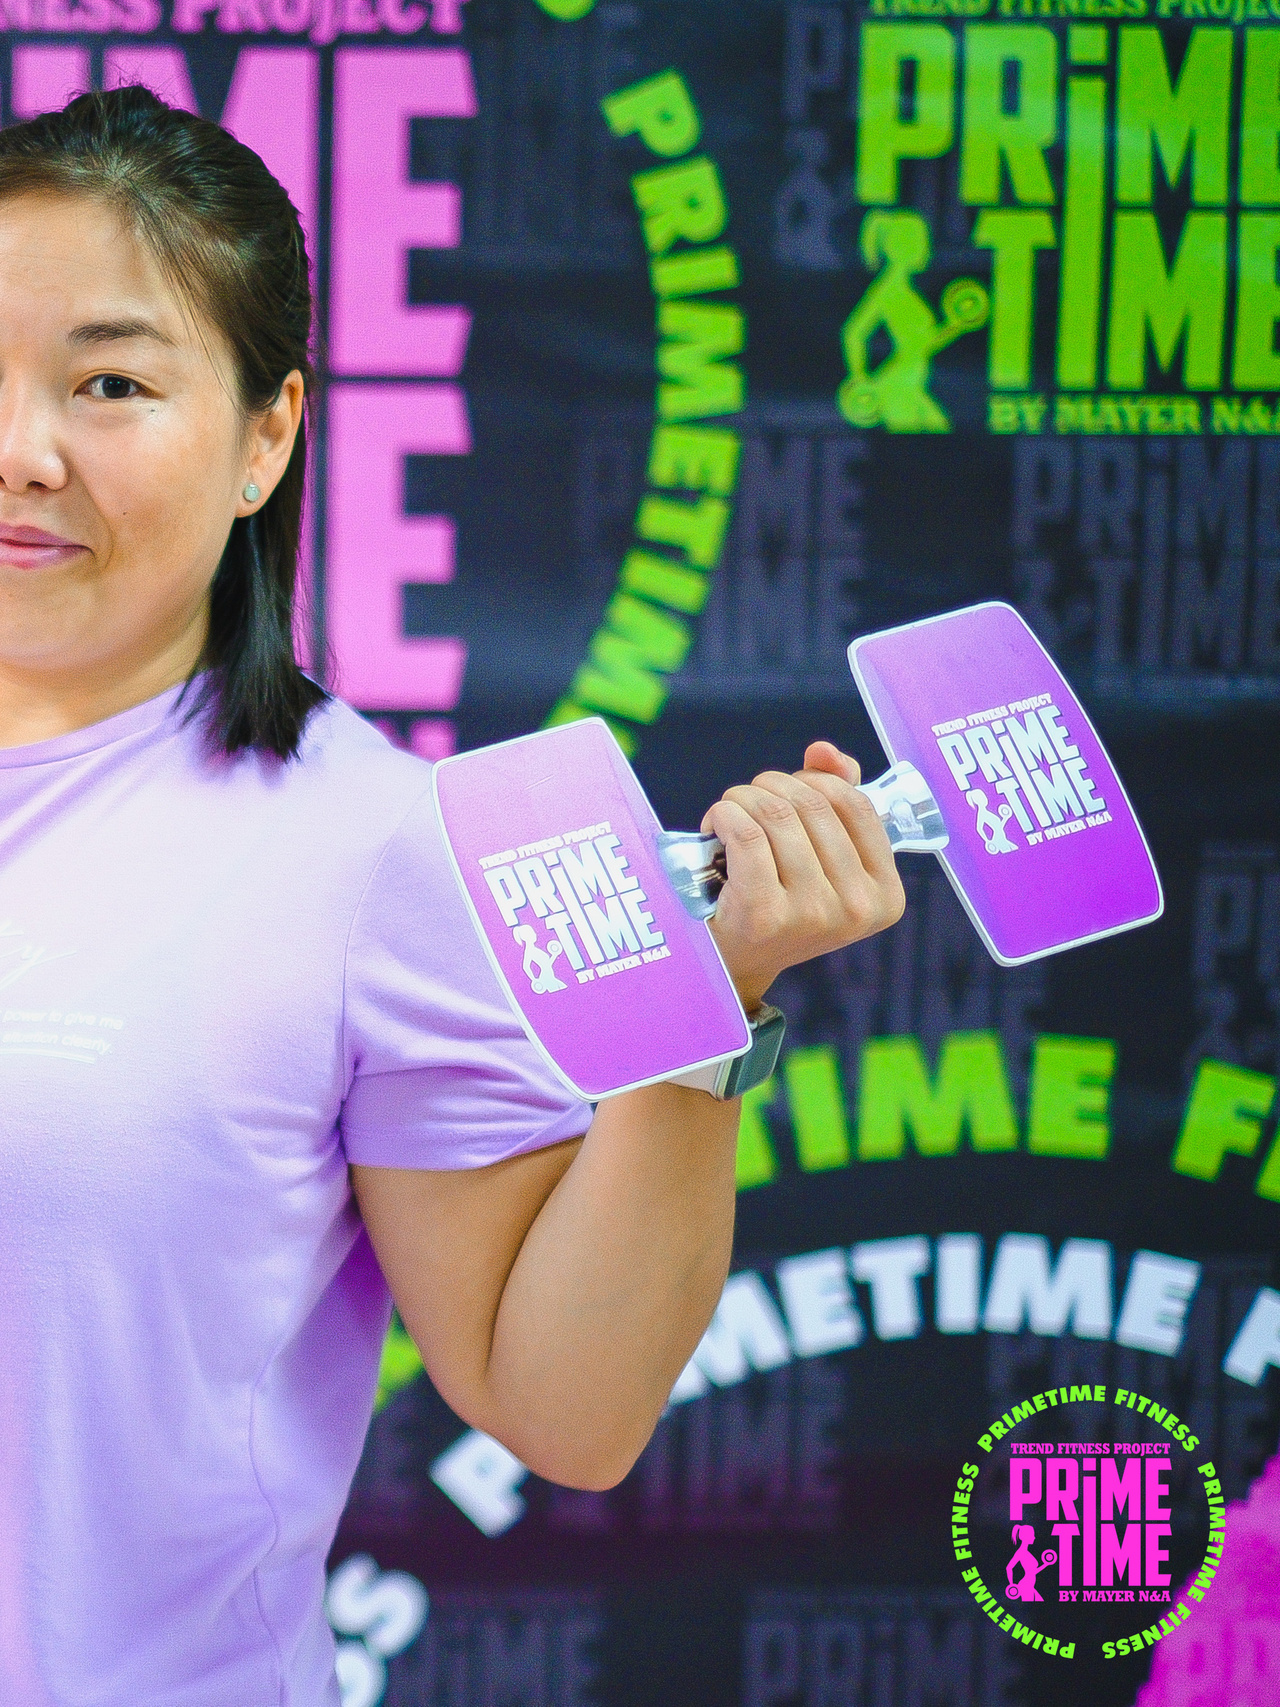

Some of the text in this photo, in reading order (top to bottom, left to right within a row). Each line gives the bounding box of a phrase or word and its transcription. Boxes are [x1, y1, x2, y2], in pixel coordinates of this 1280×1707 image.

[544, 66, 747, 758] PRIMETIM
[995, 757, 1107, 833] TIME
[545, 889, 665, 971] TIME
[2, 1009, 47, 1025] power
[48, 1009, 62, 1022] to
[64, 1011, 96, 1028] give
[98, 1015, 125, 1031] me
